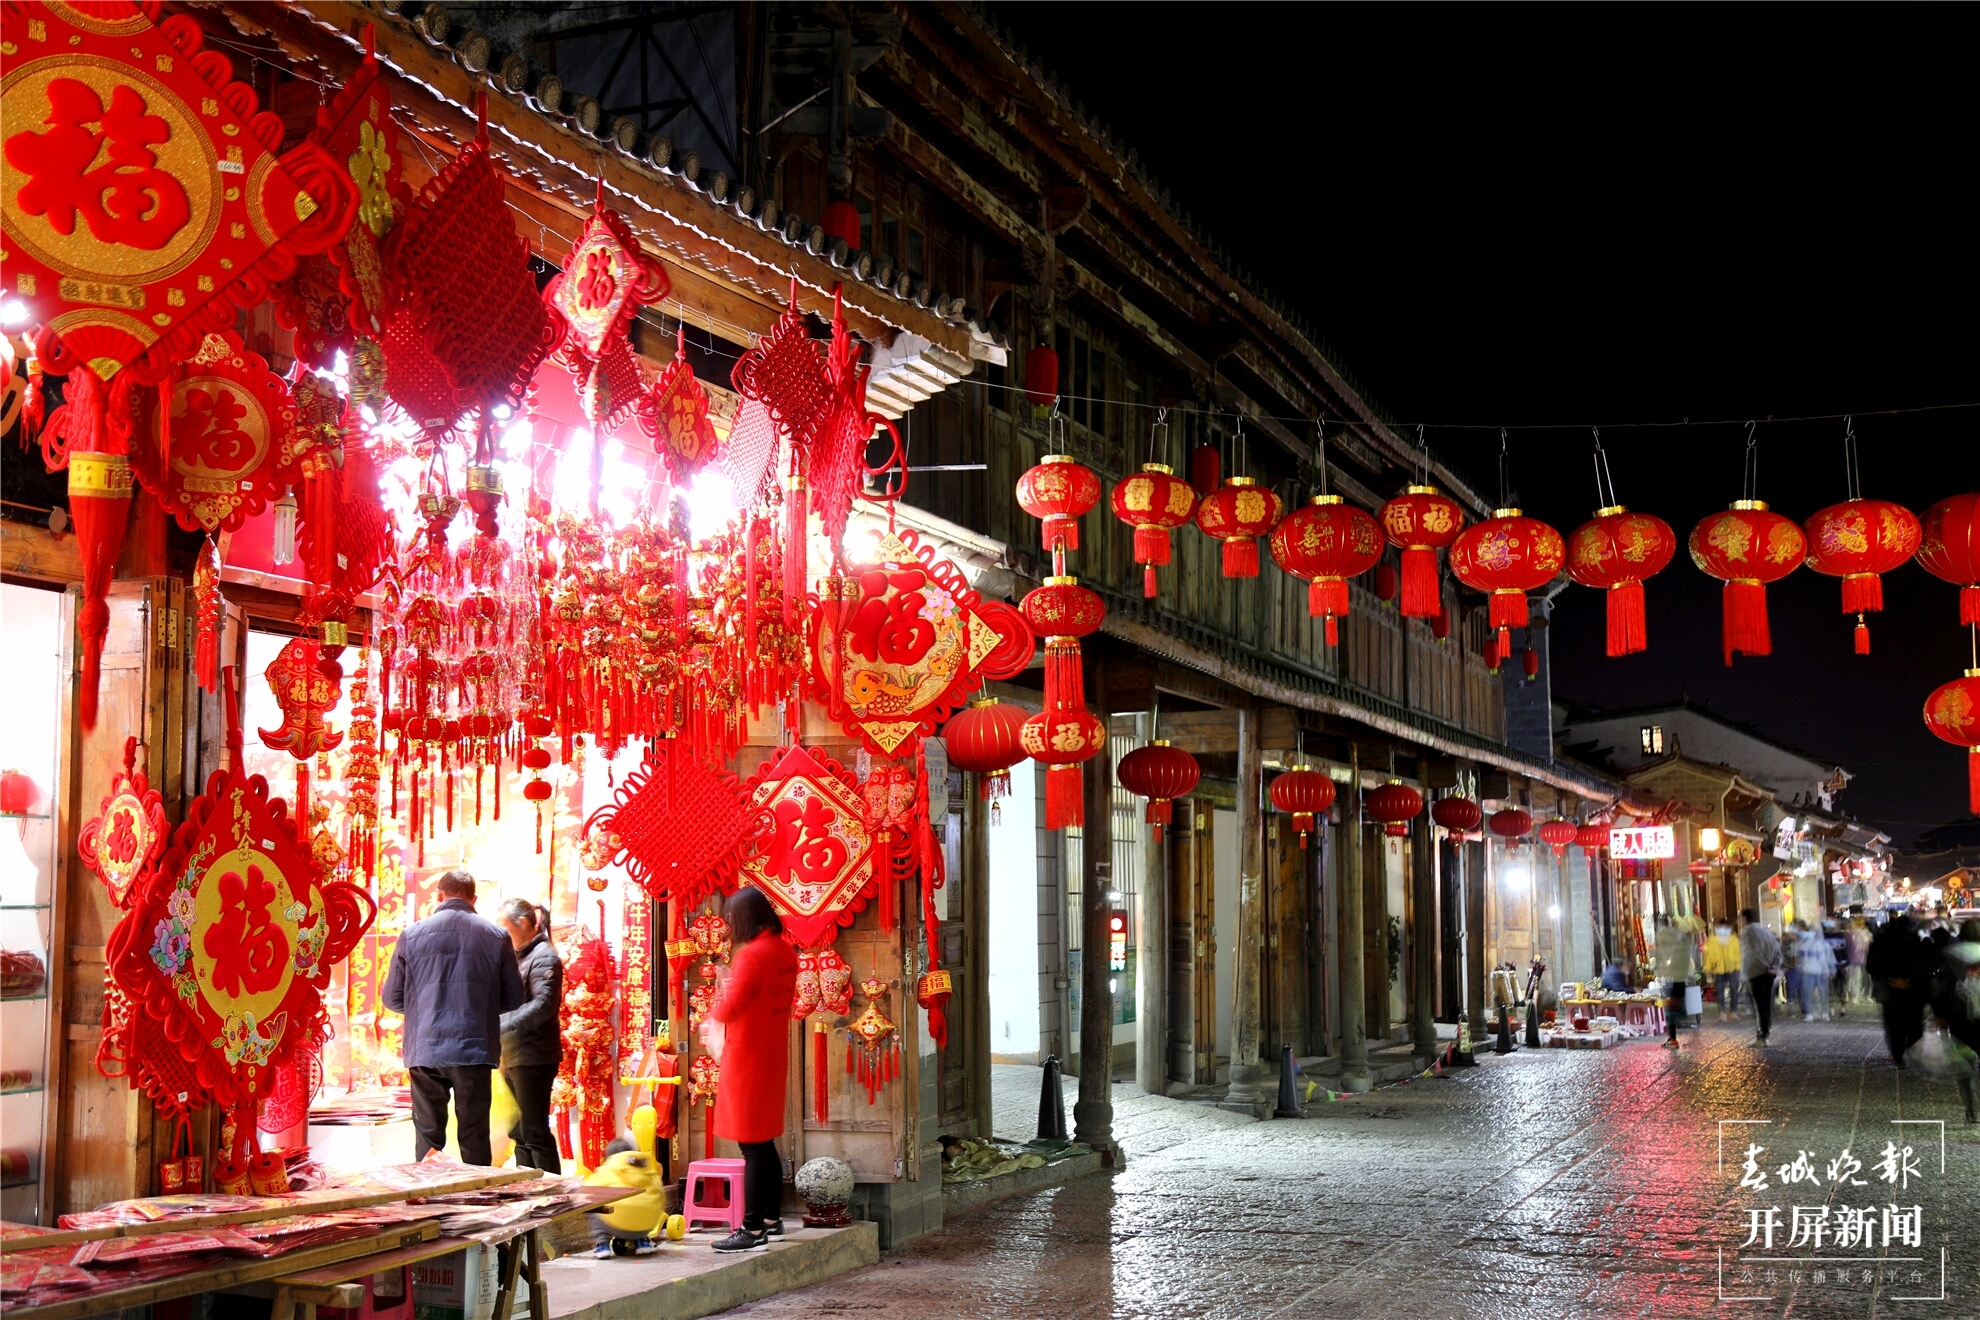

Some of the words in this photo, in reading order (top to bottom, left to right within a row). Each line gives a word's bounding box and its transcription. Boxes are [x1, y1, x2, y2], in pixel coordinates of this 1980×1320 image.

[4, 77, 191, 250] 福
[349, 120, 394, 238] 福
[577, 249, 615, 311] 福
[166, 388, 256, 473] 福
[668, 395, 700, 462] 福
[1384, 503, 1413, 534] 福
[1423, 503, 1452, 534] 福
[850, 570, 936, 667] 福
[289, 679, 307, 702] 福
[309, 680, 328, 703] 福
[1051, 722, 1086, 752] 福
[106, 808, 138, 863] 福
[757, 796, 848, 884] 福
[203, 864, 291, 999] 福
[803, 983, 815, 996] 福
[825, 981, 837, 993] 福
[929, 976, 945, 989] 福
